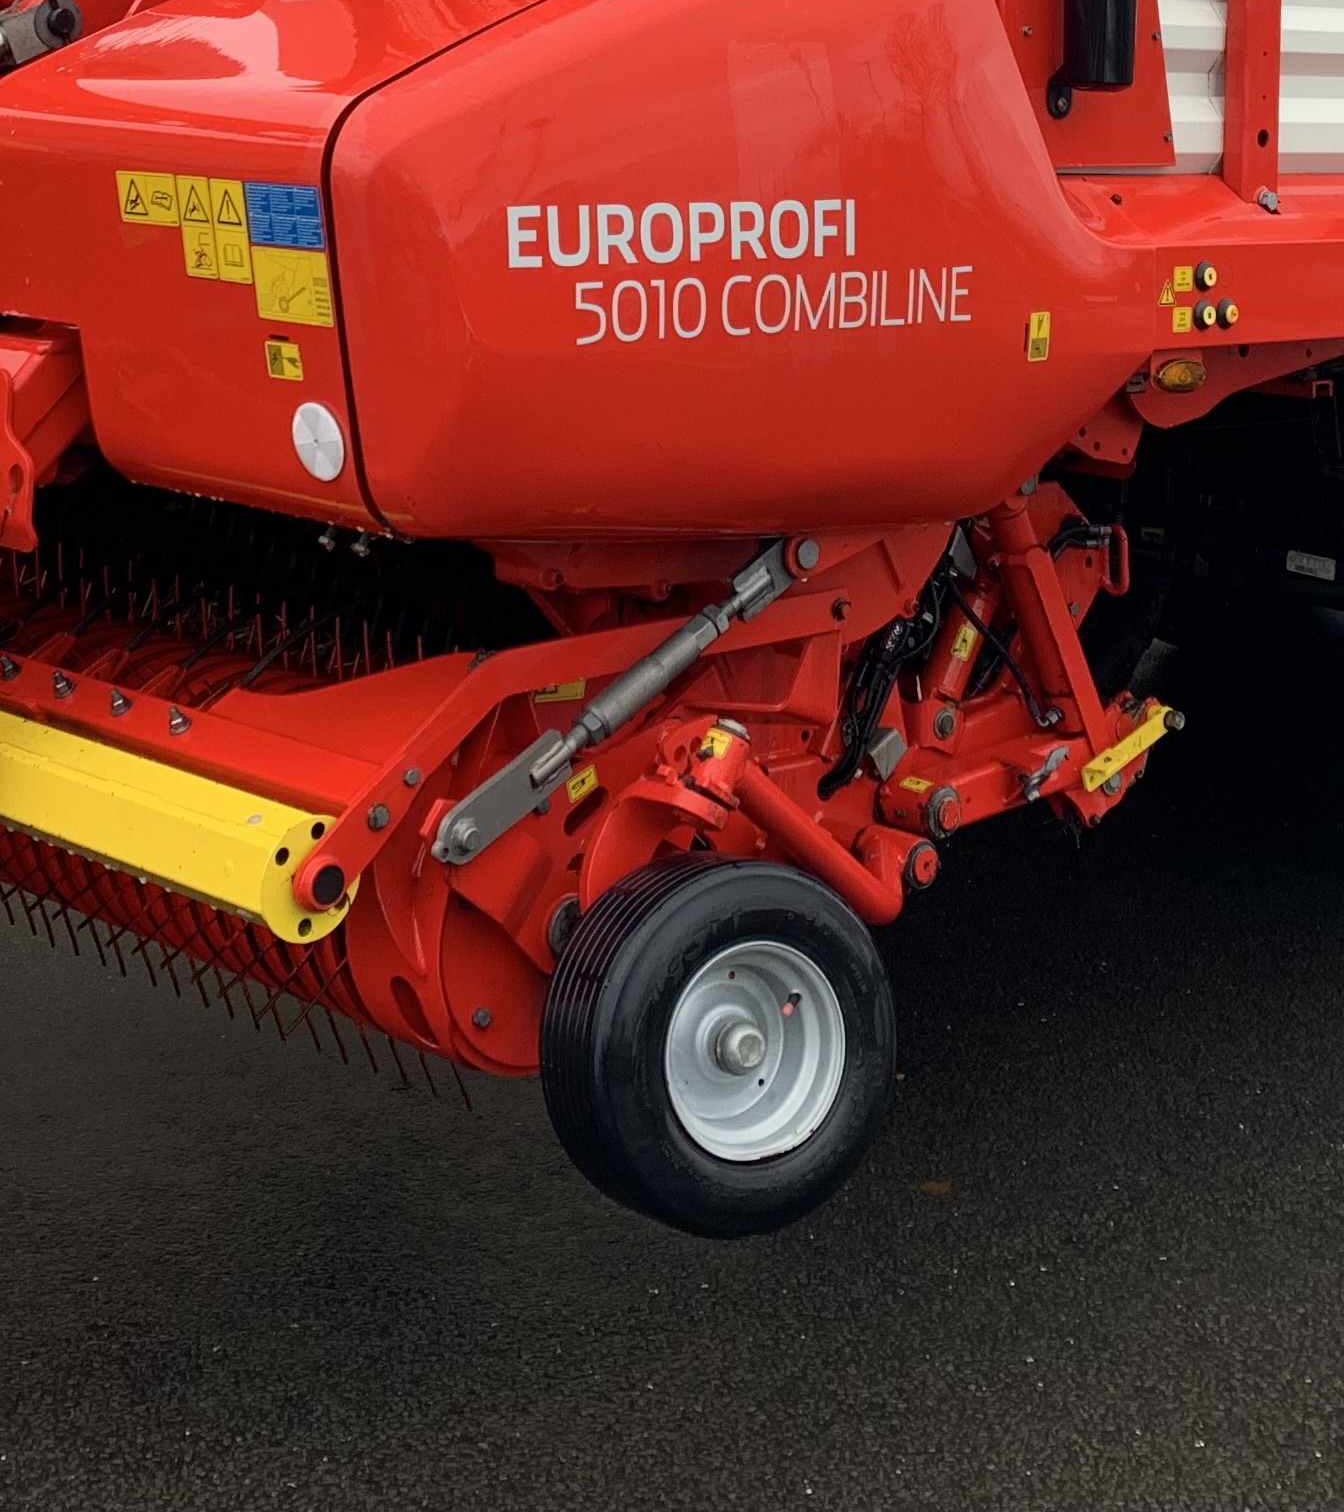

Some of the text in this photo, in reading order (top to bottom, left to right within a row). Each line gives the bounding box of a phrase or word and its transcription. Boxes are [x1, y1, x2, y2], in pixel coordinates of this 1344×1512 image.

[506, 198, 856, 269] EUROPROFI
[575, 265, 974, 346] 5010 COMBILINE
